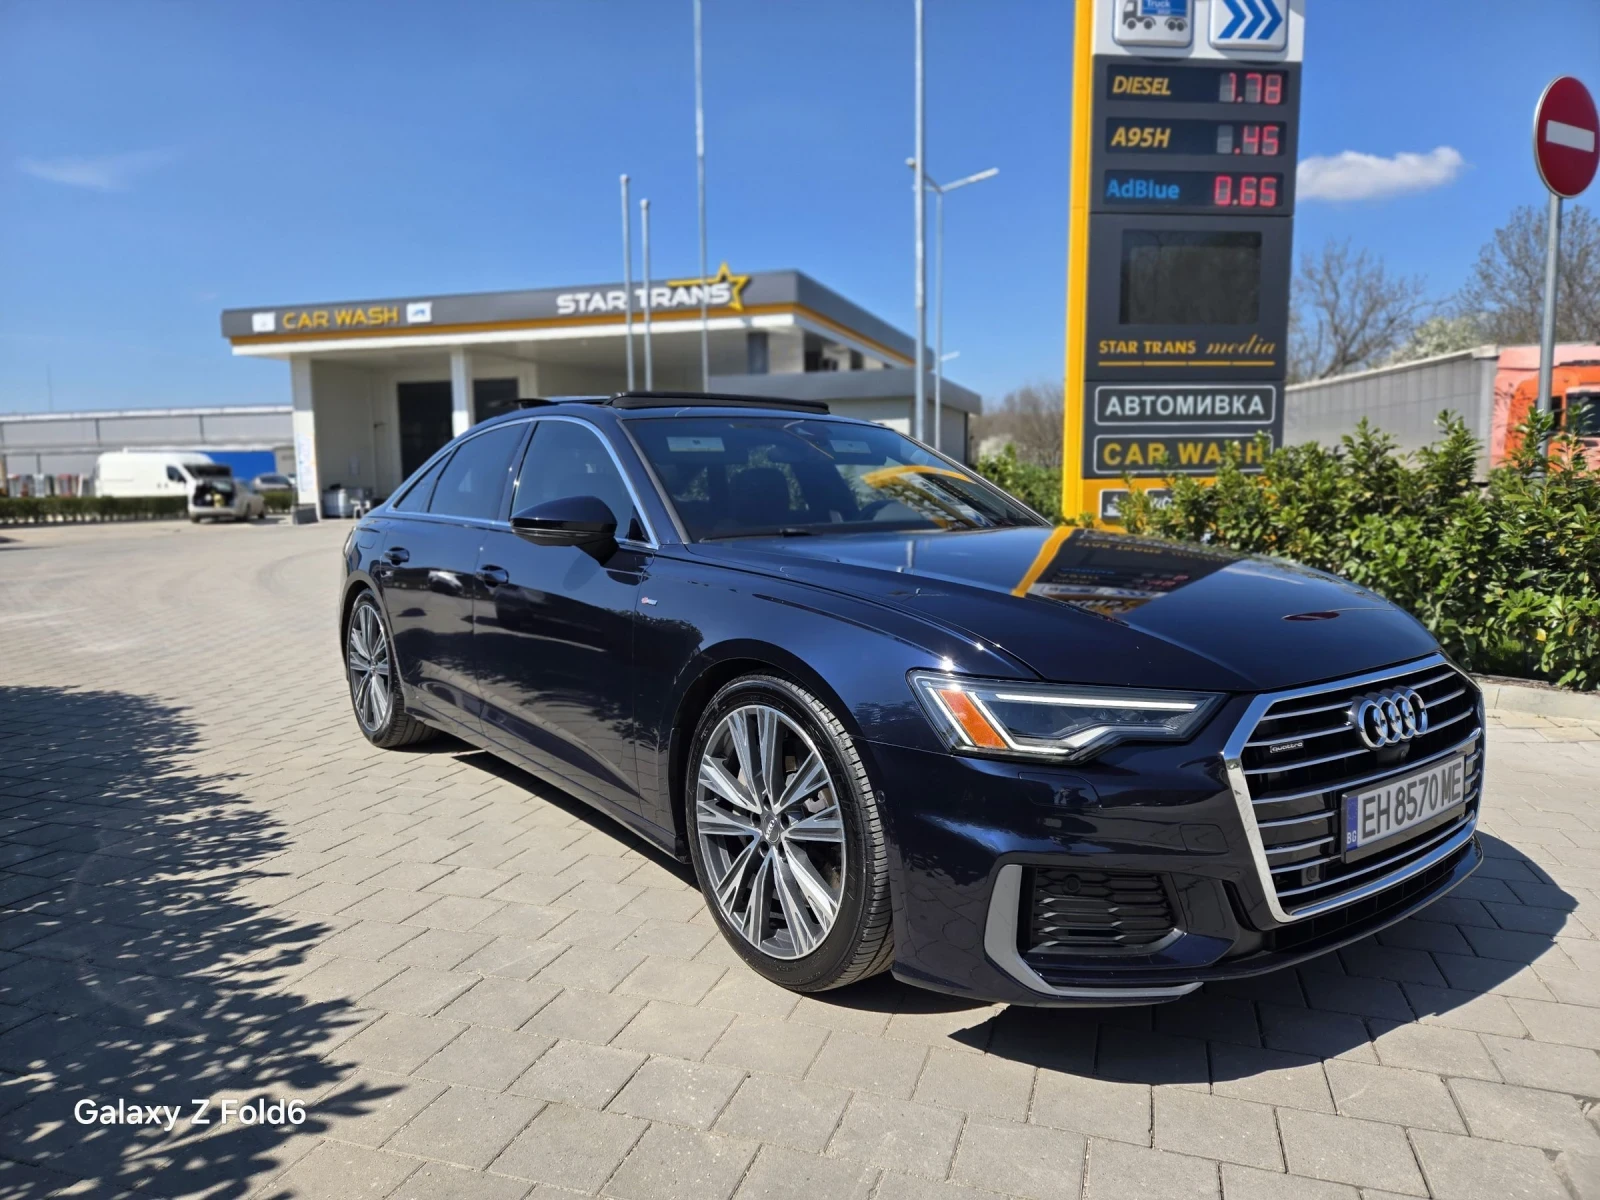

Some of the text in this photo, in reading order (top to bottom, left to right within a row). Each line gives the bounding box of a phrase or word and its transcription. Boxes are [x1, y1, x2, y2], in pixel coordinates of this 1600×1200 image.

[1112, 73, 1282, 104] DIESEL 1.78
[1111, 127, 1171, 148] A95H
[1106, 176, 1277, 207] AdBlue 0.65
[556, 282, 731, 314] STAR TRANS
[282, 306, 399, 329] CAR WASH
[1099, 334, 1276, 355] STAR TRANS media
[1105, 395, 1265, 416] АВТОМИВКА
[1103, 442, 1166, 466] CAR
[1362, 762, 1462, 840] EH 8570 ME
[1346, 830, 1357, 844] BG
